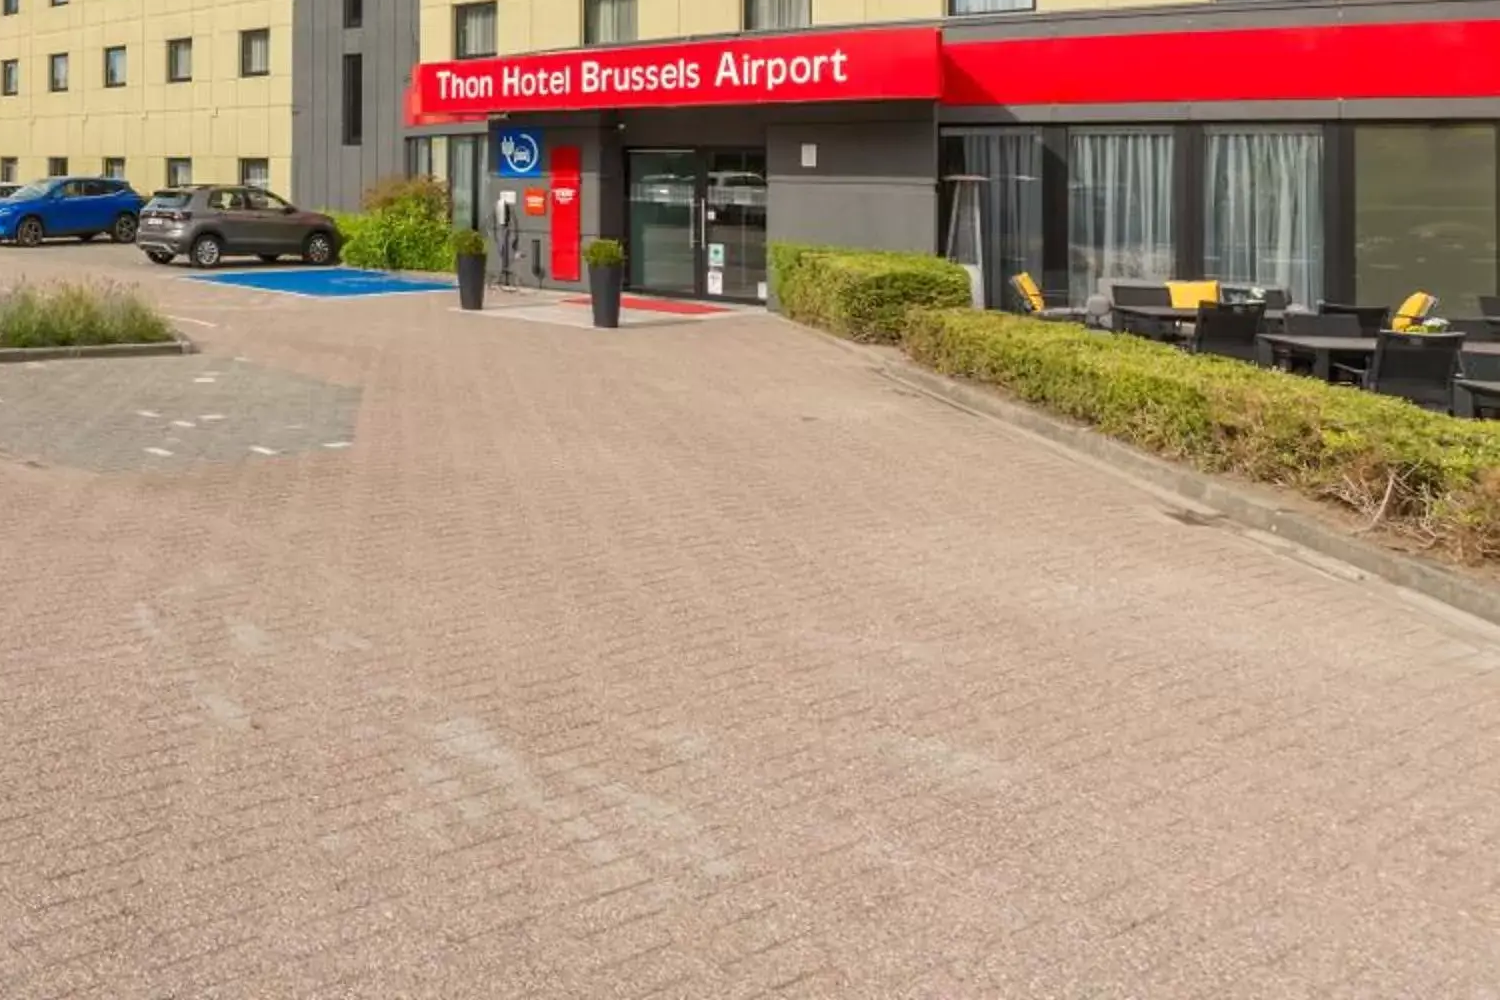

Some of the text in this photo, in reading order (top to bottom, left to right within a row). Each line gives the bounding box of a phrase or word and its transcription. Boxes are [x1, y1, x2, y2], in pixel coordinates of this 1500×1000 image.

[436, 48, 848, 100] Thon Hotel Brussels Airport
